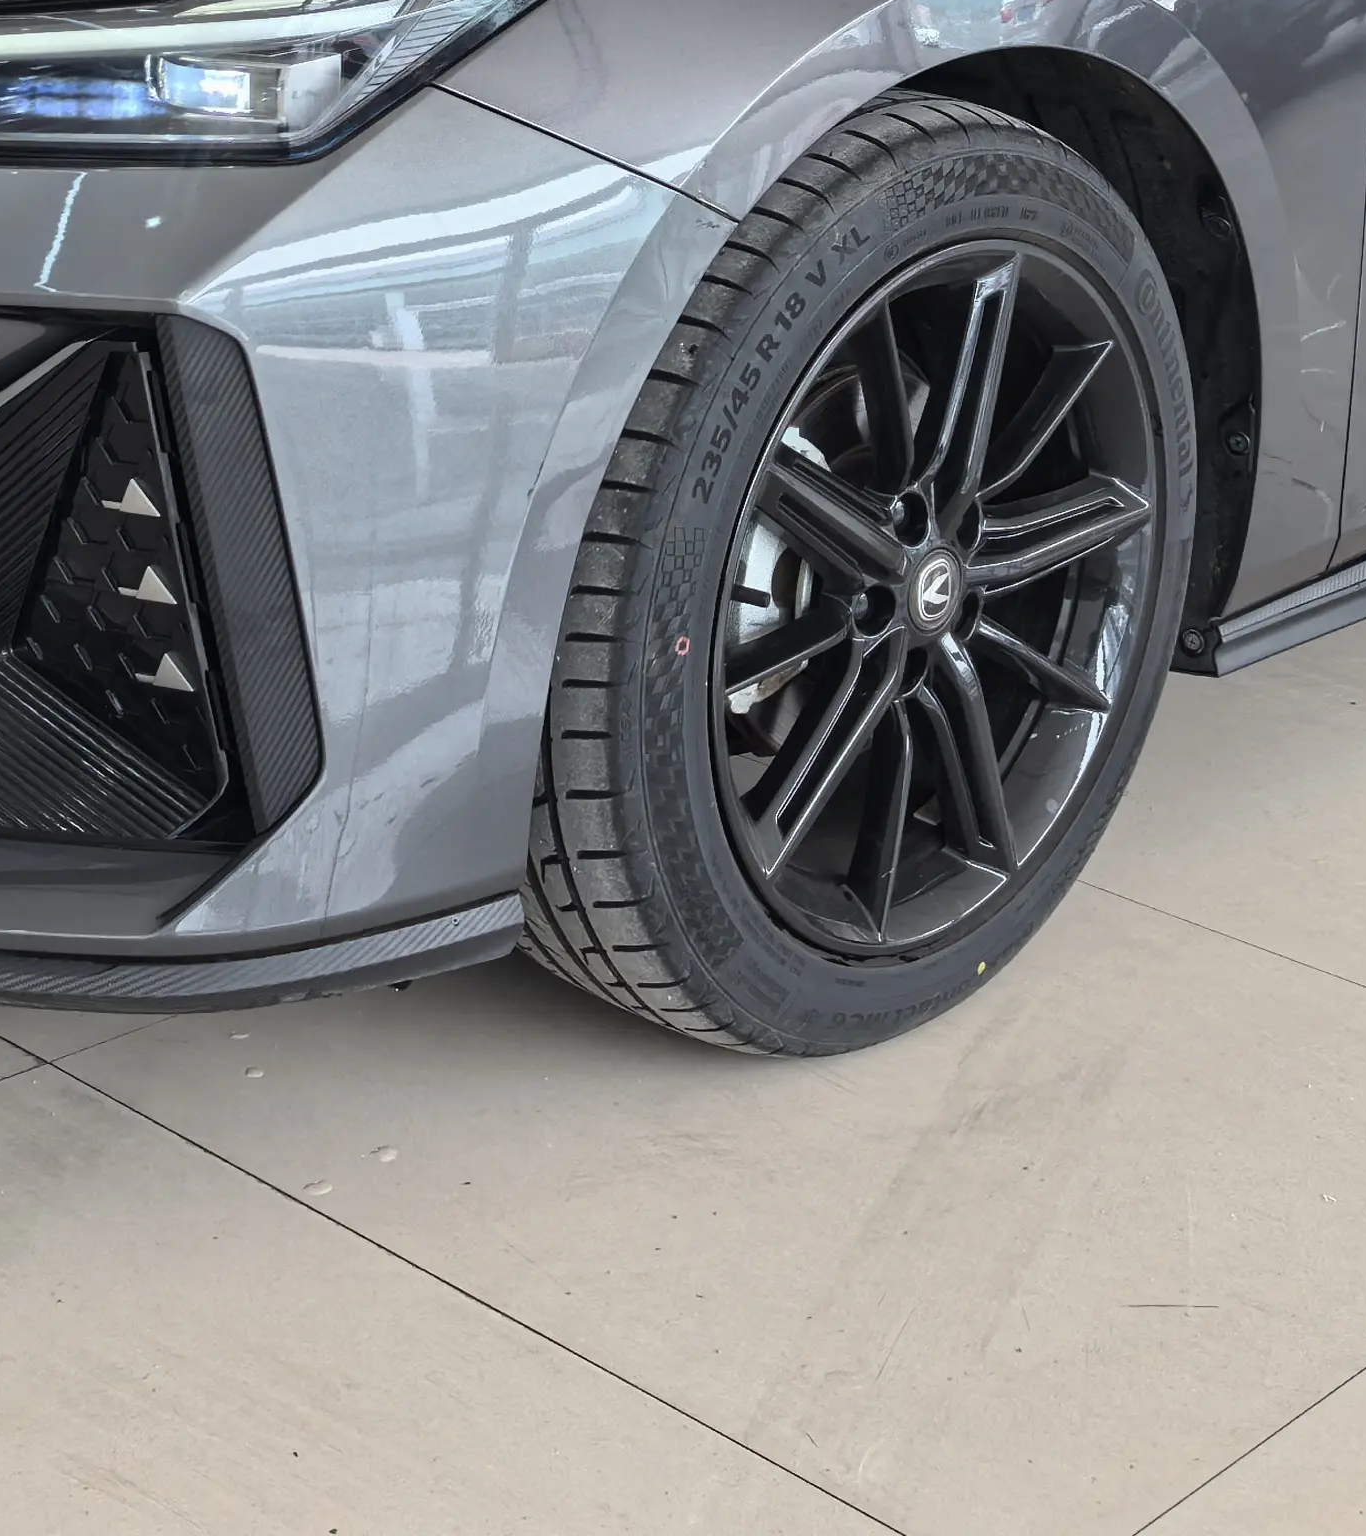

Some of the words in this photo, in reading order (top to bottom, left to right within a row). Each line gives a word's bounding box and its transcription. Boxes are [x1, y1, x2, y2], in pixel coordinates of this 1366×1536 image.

[691, 361, 762, 505] 235/45
[754, 333, 782, 364] R
[774, 291, 807, 332] 18
[804, 258, 827, 288] V
[830, 226, 871, 265] XL
[1136, 267, 1194, 479] Continental
